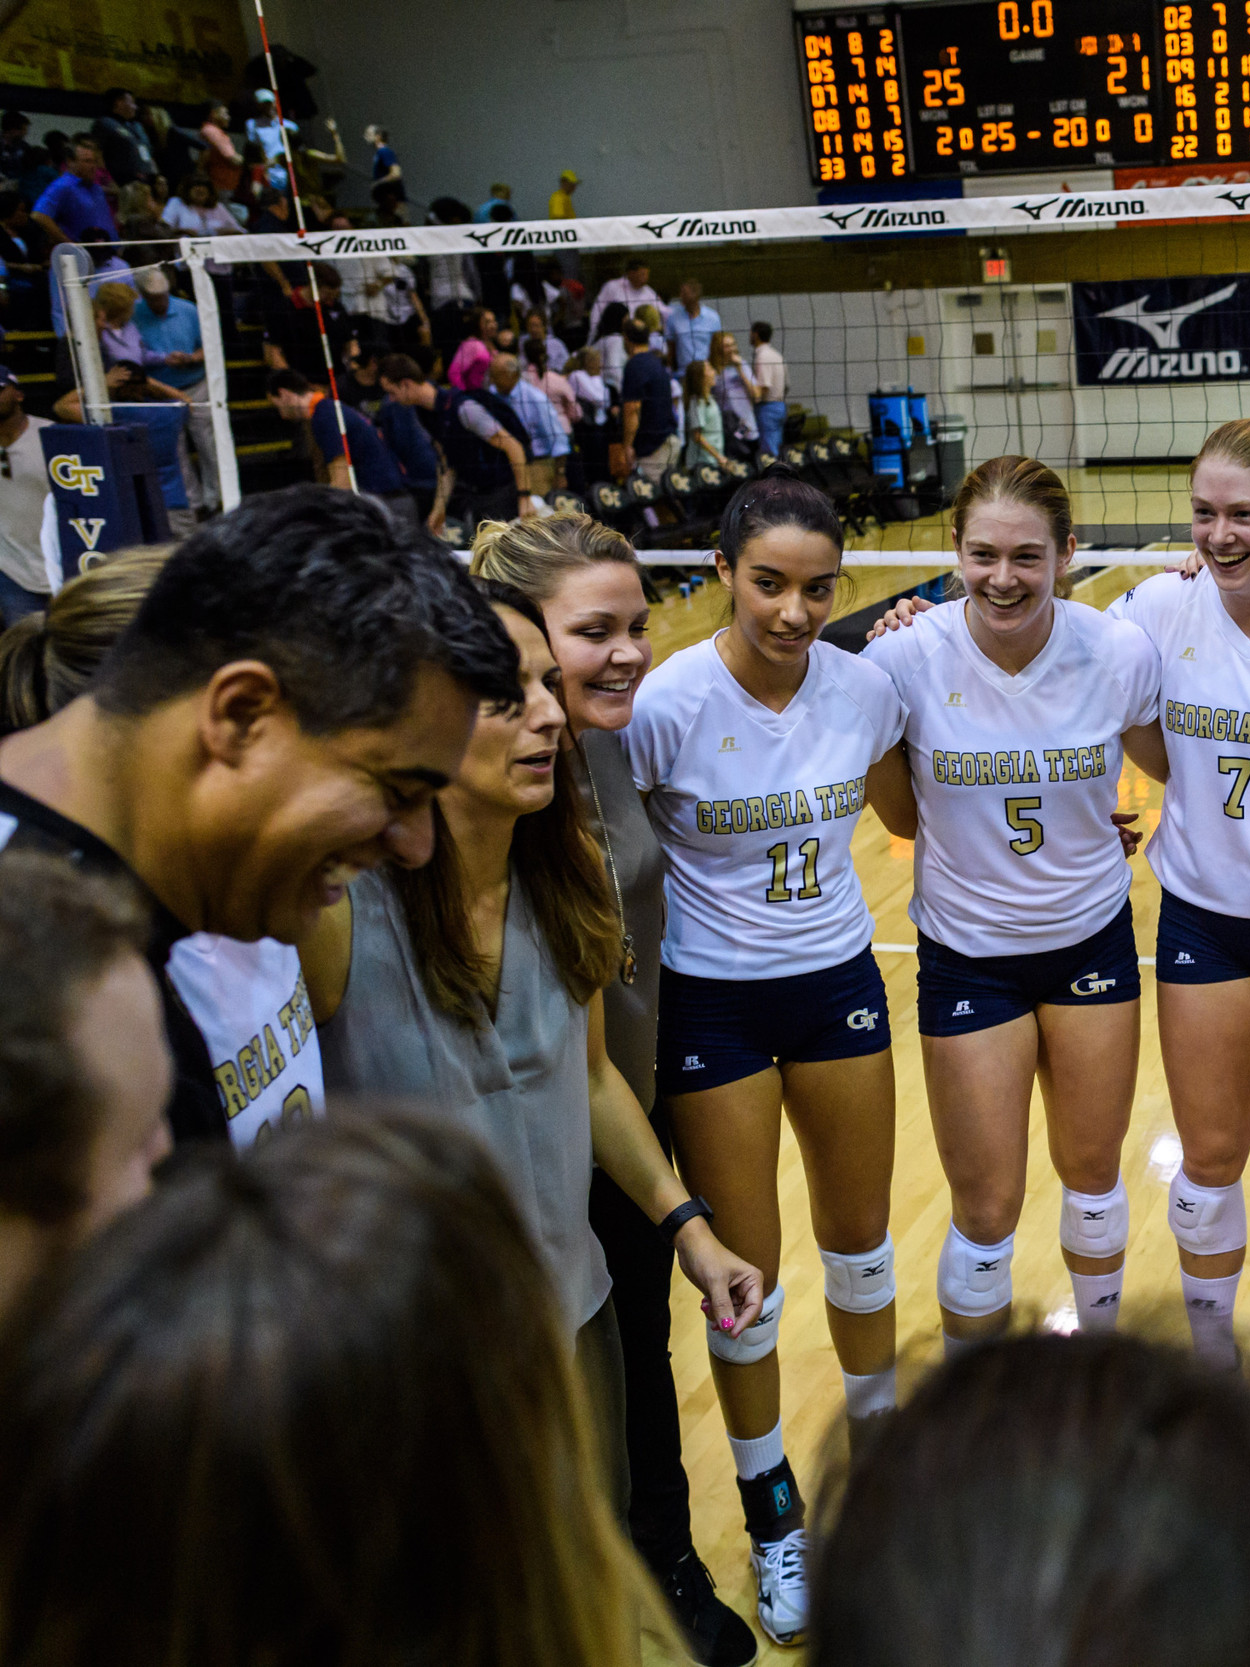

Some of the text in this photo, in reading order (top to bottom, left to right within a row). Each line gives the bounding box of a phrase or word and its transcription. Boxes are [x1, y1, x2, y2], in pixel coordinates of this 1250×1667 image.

[997, 0, 1054, 40] 0.0
[1164, 5, 1192, 31] 02
[1212, 2, 1227, 26] 7
[805, 29, 893, 59] 04 8 2
[1165, 31, 1194, 57] 03
[1212, 29, 1227, 53] 0
[807, 55, 897, 83] 05 7 14
[1107, 55, 1150, 95] 21
[1166, 58, 1195, 83] 09
[1207, 56, 1229, 78] 11
[810, 79, 899, 108] 07 14 8
[923, 67, 965, 107] 25
[1175, 83, 1196, 107] 16
[1215, 81, 1229, 105] 2
[813, 104, 902, 132] 08 0 7
[1176, 109, 1198, 132] 17
[1215, 107, 1231, 131] 0
[822, 128, 904, 155] 11 14 15
[936, 113, 1153, 155] 2 0 25 20 0 0
[1171, 134, 1198, 159] 22
[1216, 132, 1232, 156] 0
[819, 153, 905, 181] 33 0 2
[334, 236, 406, 253] MIZUNO
[502, 227, 577, 245] MIZUNO
[677, 218, 757, 236] MIZUNO
[860, 207, 946, 228] MIZUNO
[1055, 198, 1146, 218] MIZUNO
[1098, 348, 1242, 379] MIZUNO
[50, 454, 104, 496] GT
[933, 744, 1106, 785] GEORGIA TECH
[696, 775, 866, 834] GEORGIA TECH
[1004, 796, 1044, 856] 5
[766, 838, 821, 903] 11
[847, 1007, 878, 1031] GT
